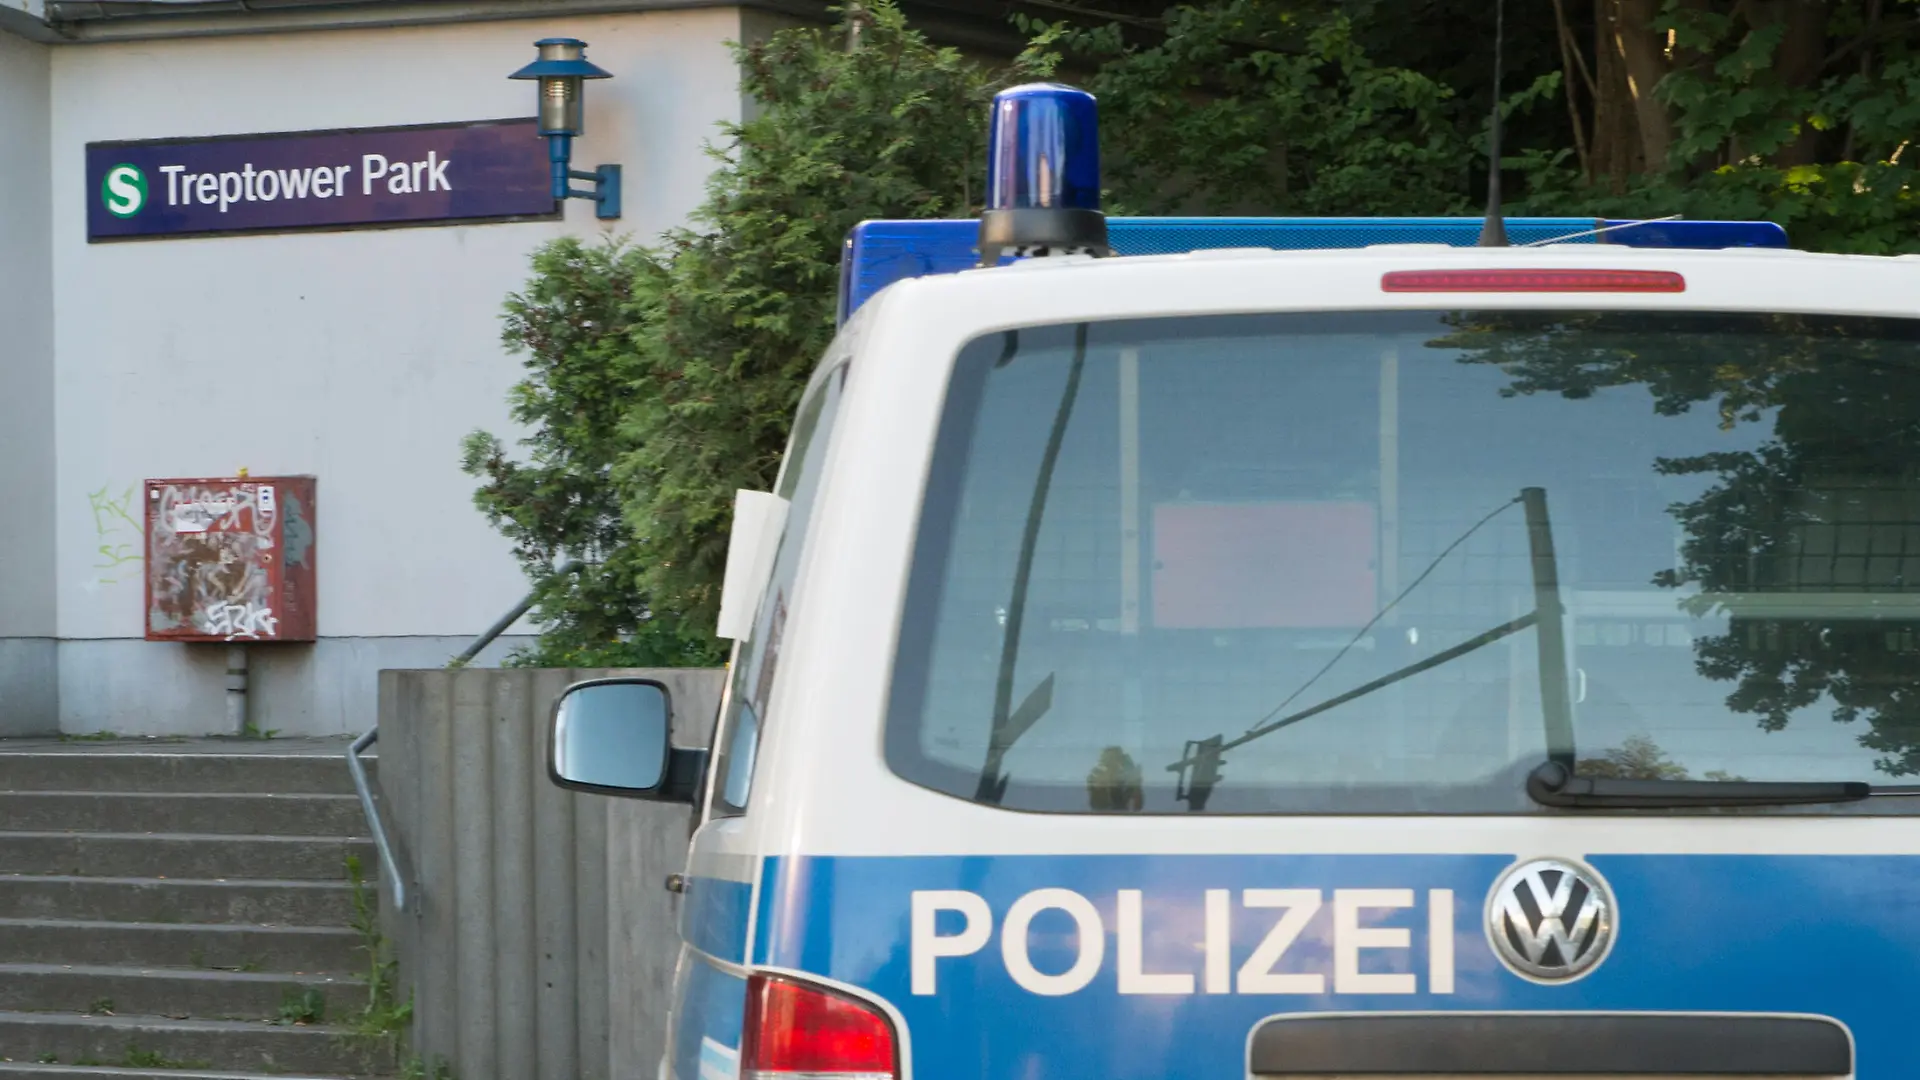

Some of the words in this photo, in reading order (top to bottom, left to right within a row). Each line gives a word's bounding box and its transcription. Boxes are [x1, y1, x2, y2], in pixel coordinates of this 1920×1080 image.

[108, 167, 141, 214] S
[159, 163, 351, 213] Treptower
[362, 150, 452, 195] Park
[911, 887, 1455, 996] POLIZEI
[1491, 861, 1611, 979] VW
